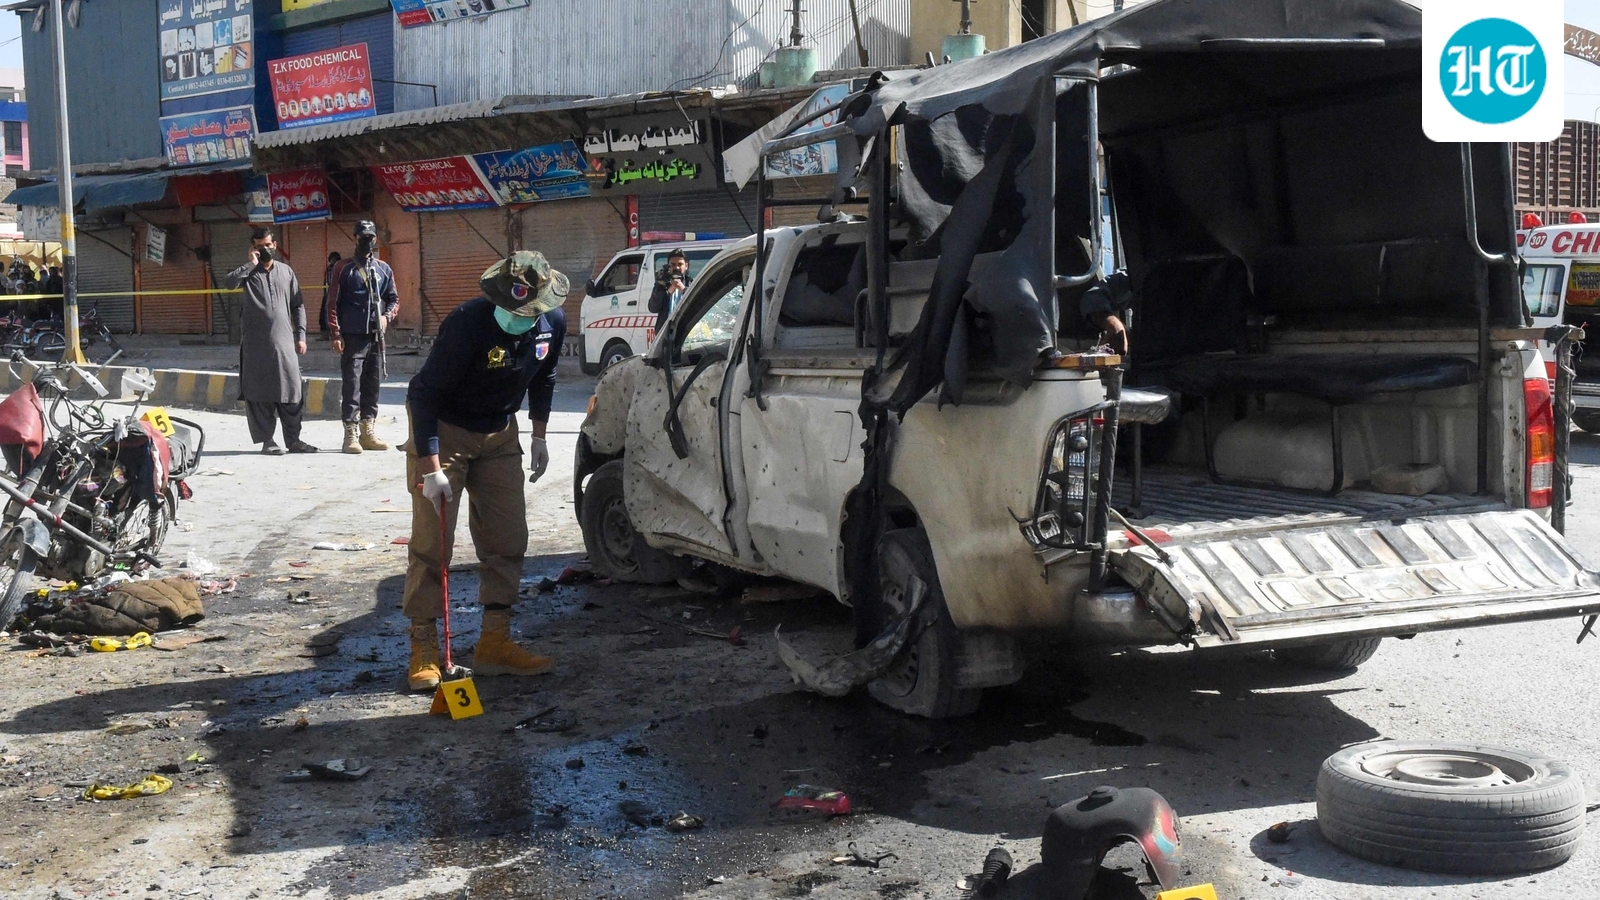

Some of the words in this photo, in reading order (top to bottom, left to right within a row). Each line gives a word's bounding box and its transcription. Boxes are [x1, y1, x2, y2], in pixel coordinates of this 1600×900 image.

[273, 62, 287, 74] Z.K
[288, 58, 312, 72] FOOD
[313, 49, 362, 67] CHEMICAL
[167, 83, 185, 94] Contact
[224, 115, 251, 137] جمیل
[641, 119, 700, 156] المدینہ
[395, 164, 416, 174] FOOD
[1529, 234, 1547, 247] 307
[155, 414, 168, 433] 5
[454, 687, 471, 707] 3
